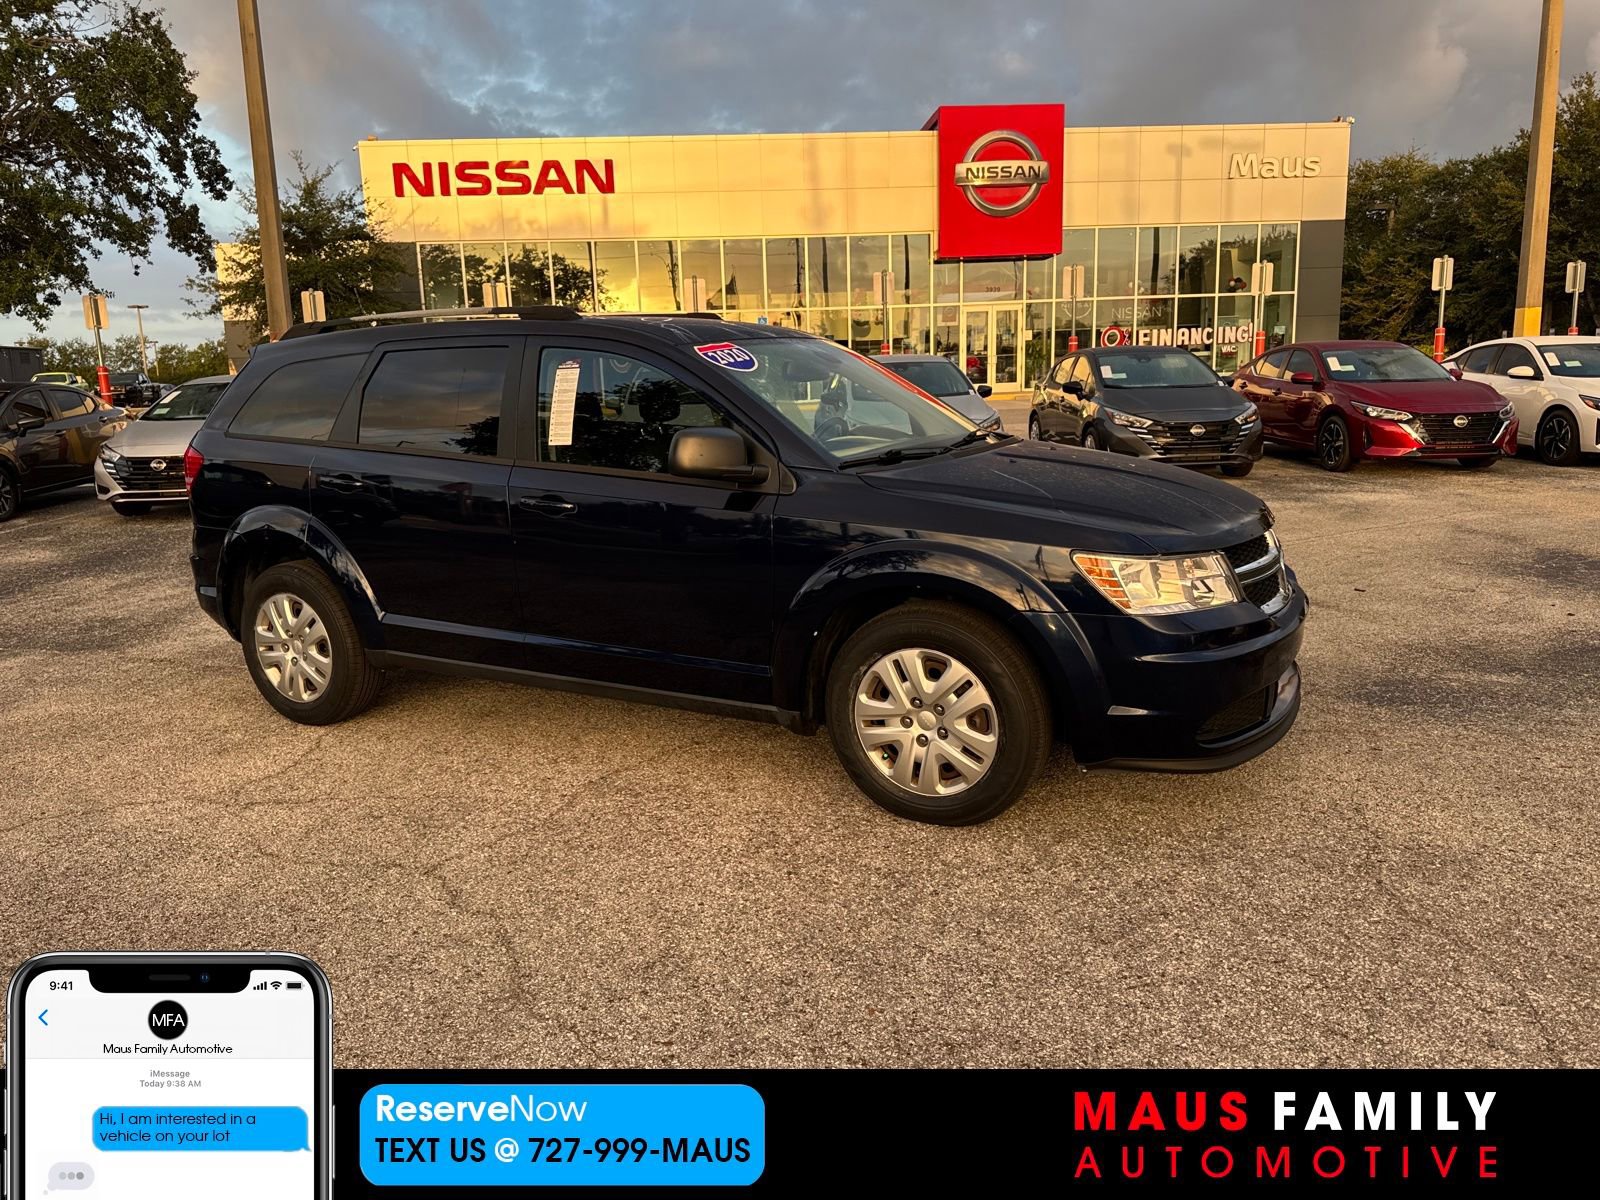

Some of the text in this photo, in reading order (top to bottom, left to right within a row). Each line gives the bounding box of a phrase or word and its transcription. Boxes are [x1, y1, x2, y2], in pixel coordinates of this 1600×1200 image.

[965, 166, 1042, 180] NISSAN
[1227, 153, 1321, 179] Maus
[392, 159, 615, 197] NISSAN
[1111, 306, 1162, 319] NISSAN
[1138, 322, 1254, 347] FINANCING!
[707, 348, 751, 365] 2020
